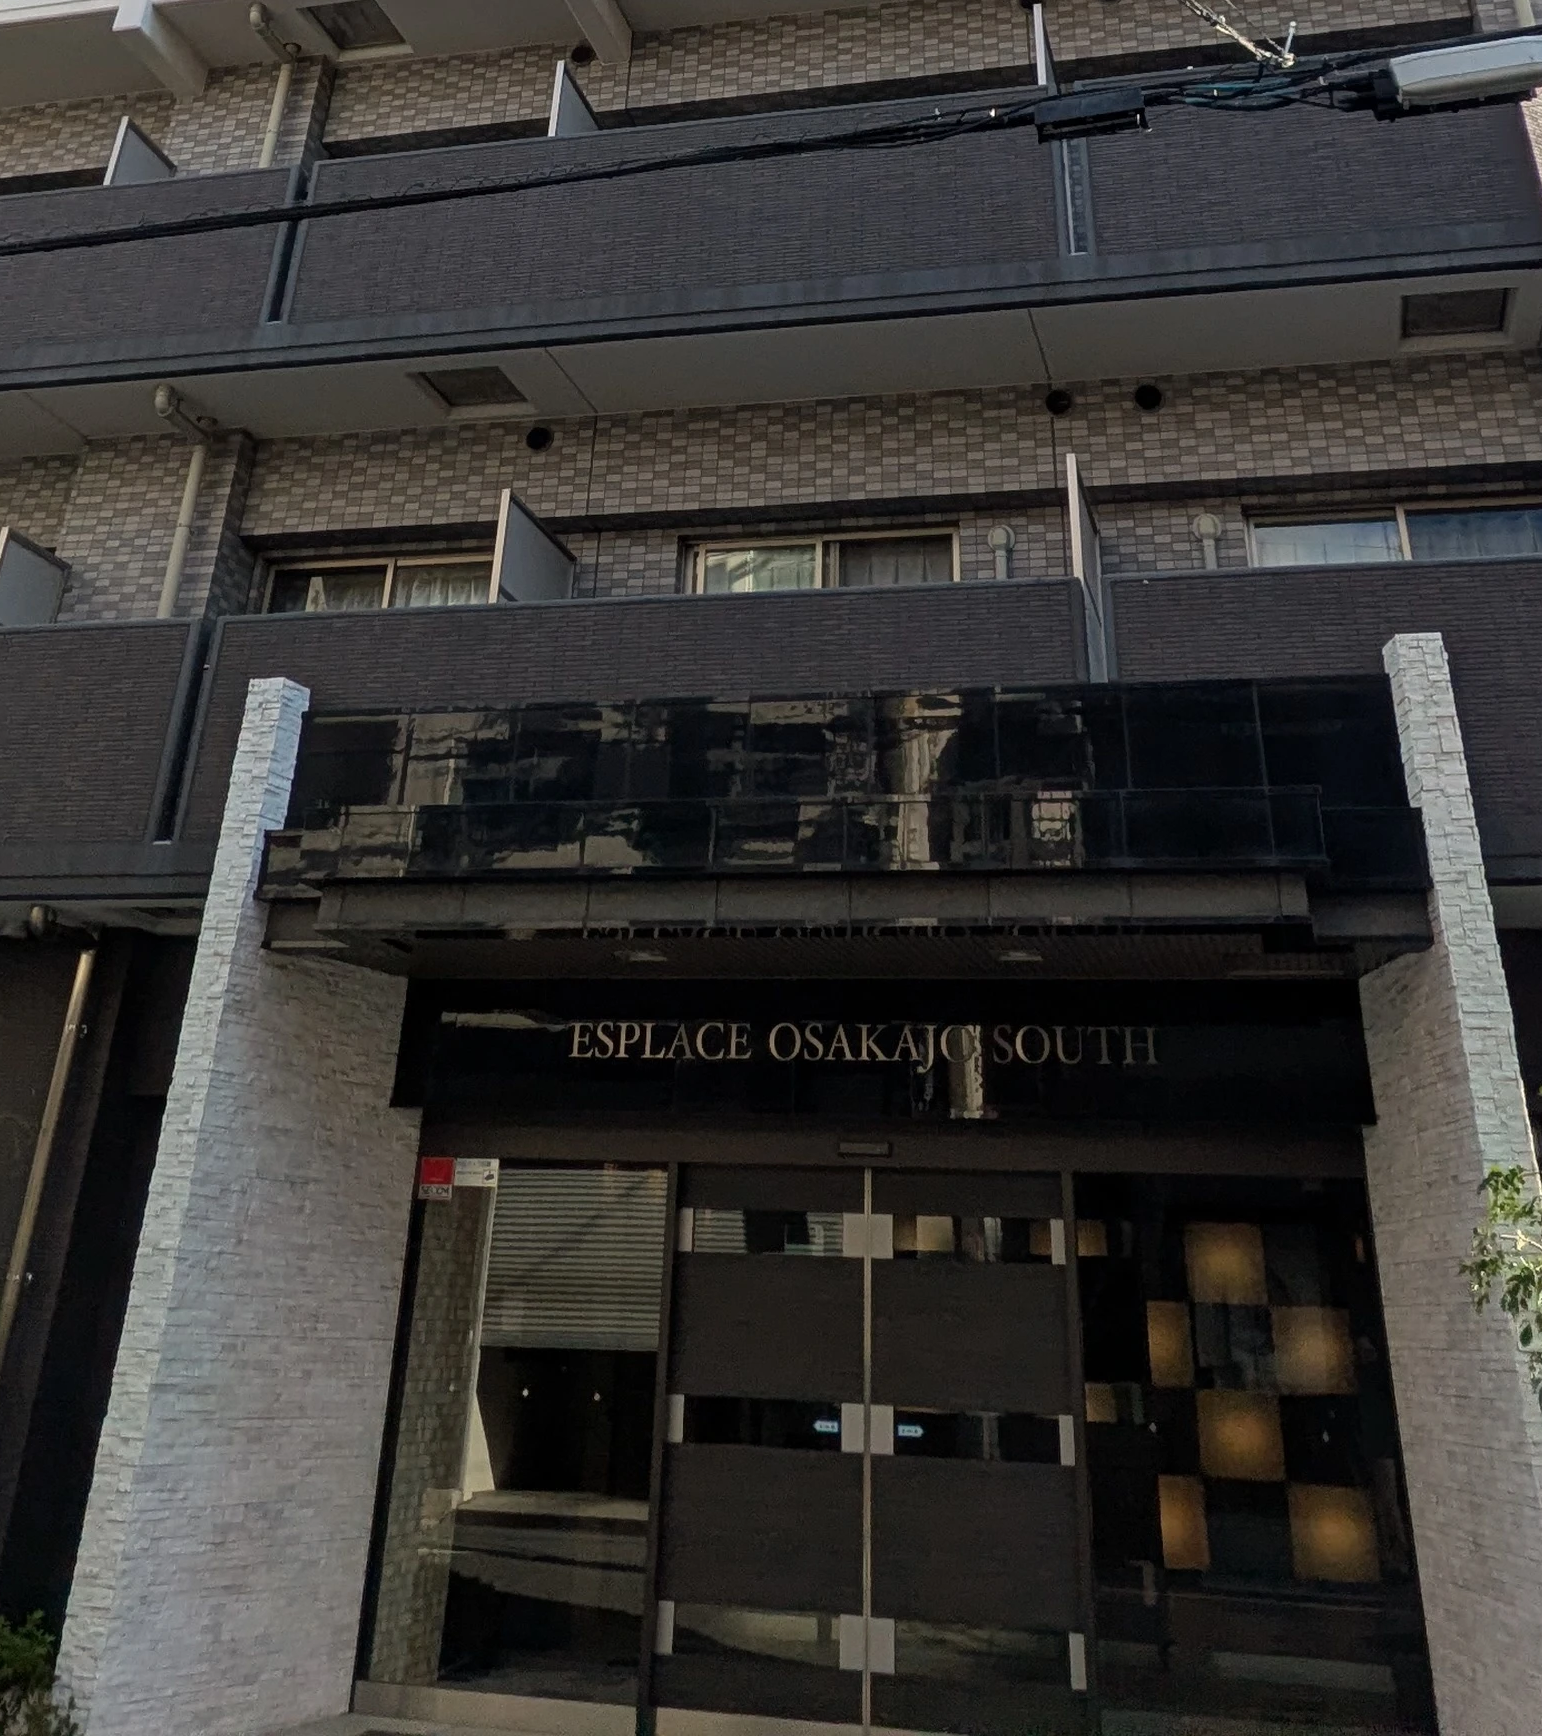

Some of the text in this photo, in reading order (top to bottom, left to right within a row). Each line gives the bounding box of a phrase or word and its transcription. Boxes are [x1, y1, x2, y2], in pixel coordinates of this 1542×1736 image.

[569, 1021, 1158, 1073] ESPLACE OSAKAJO SOUTH
